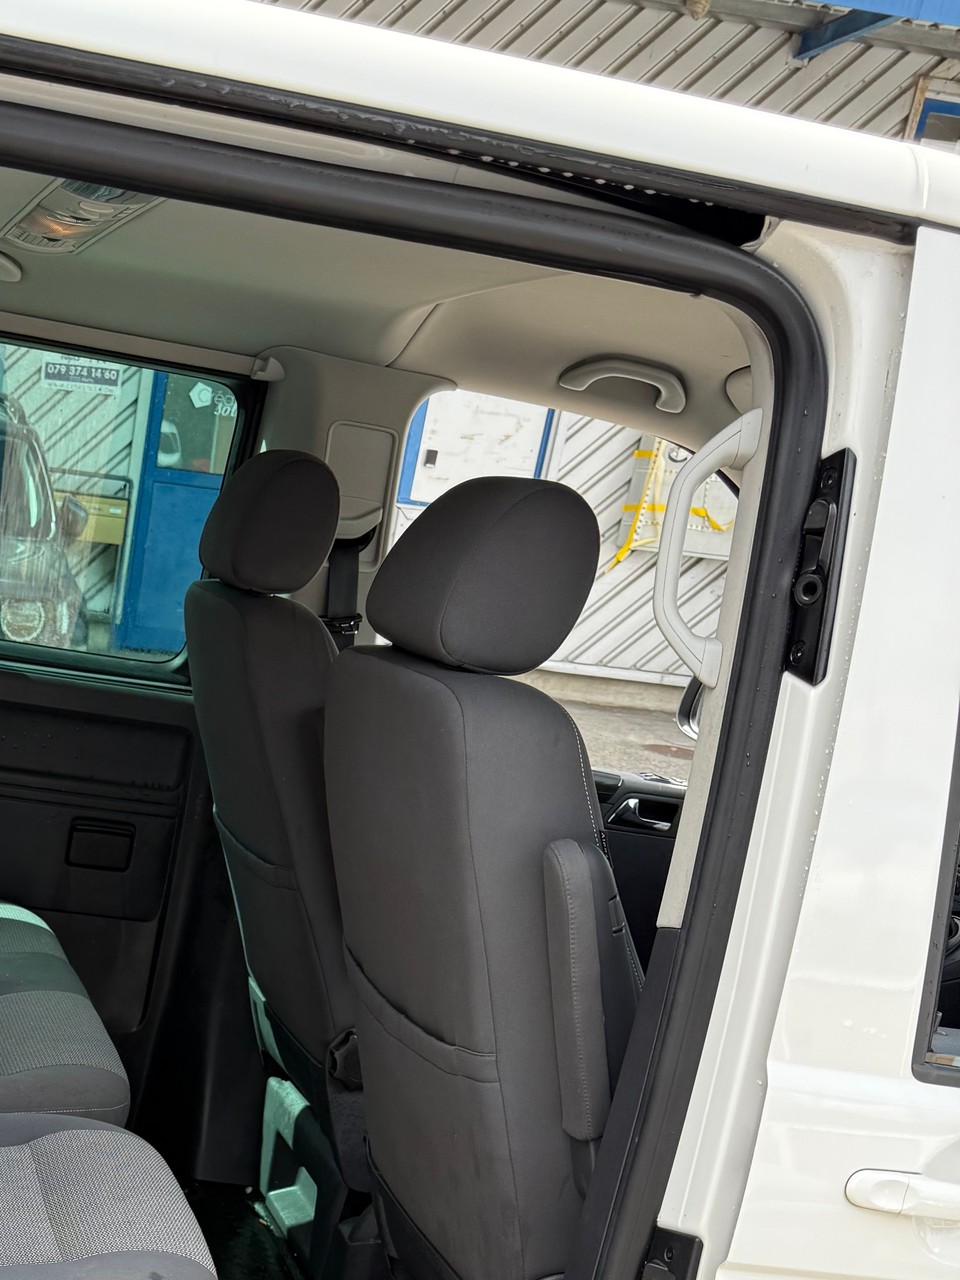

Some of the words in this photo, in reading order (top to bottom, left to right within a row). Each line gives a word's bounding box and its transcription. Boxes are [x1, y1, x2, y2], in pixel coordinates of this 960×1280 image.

[47, 364, 66, 375] 079
[69, 366, 88, 377] 374
[91, 368, 102, 378] 14
